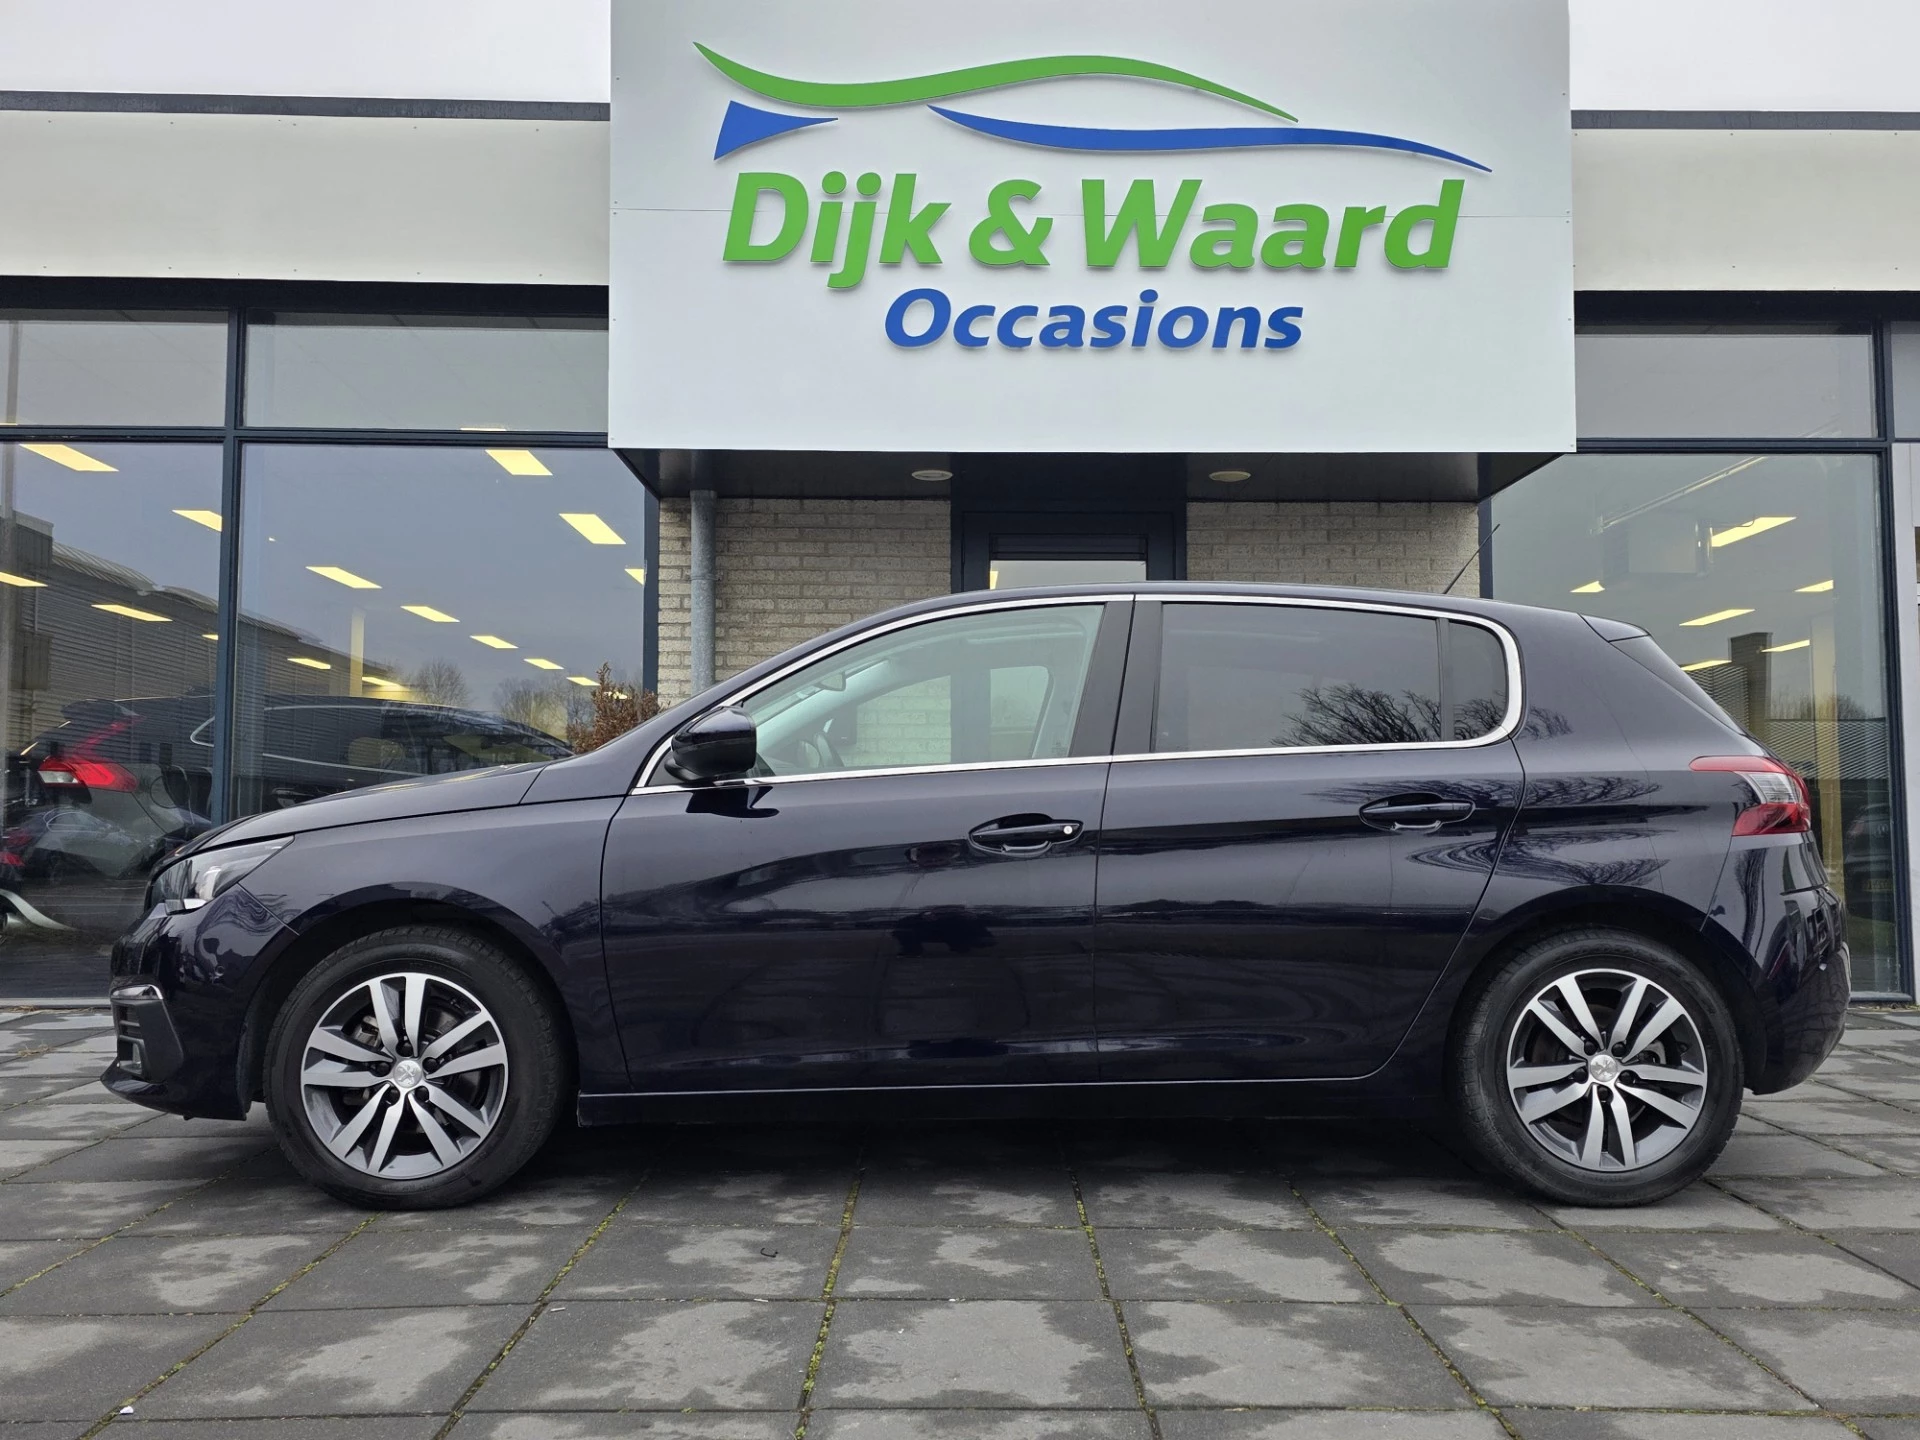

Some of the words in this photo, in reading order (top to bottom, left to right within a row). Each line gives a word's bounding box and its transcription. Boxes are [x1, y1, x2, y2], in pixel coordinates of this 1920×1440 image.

[723, 172, 950, 288] Dijk
[969, 180, 1052, 266] &
[1083, 179, 1465, 268] Waard
[884, 288, 1304, 349] Occasions
